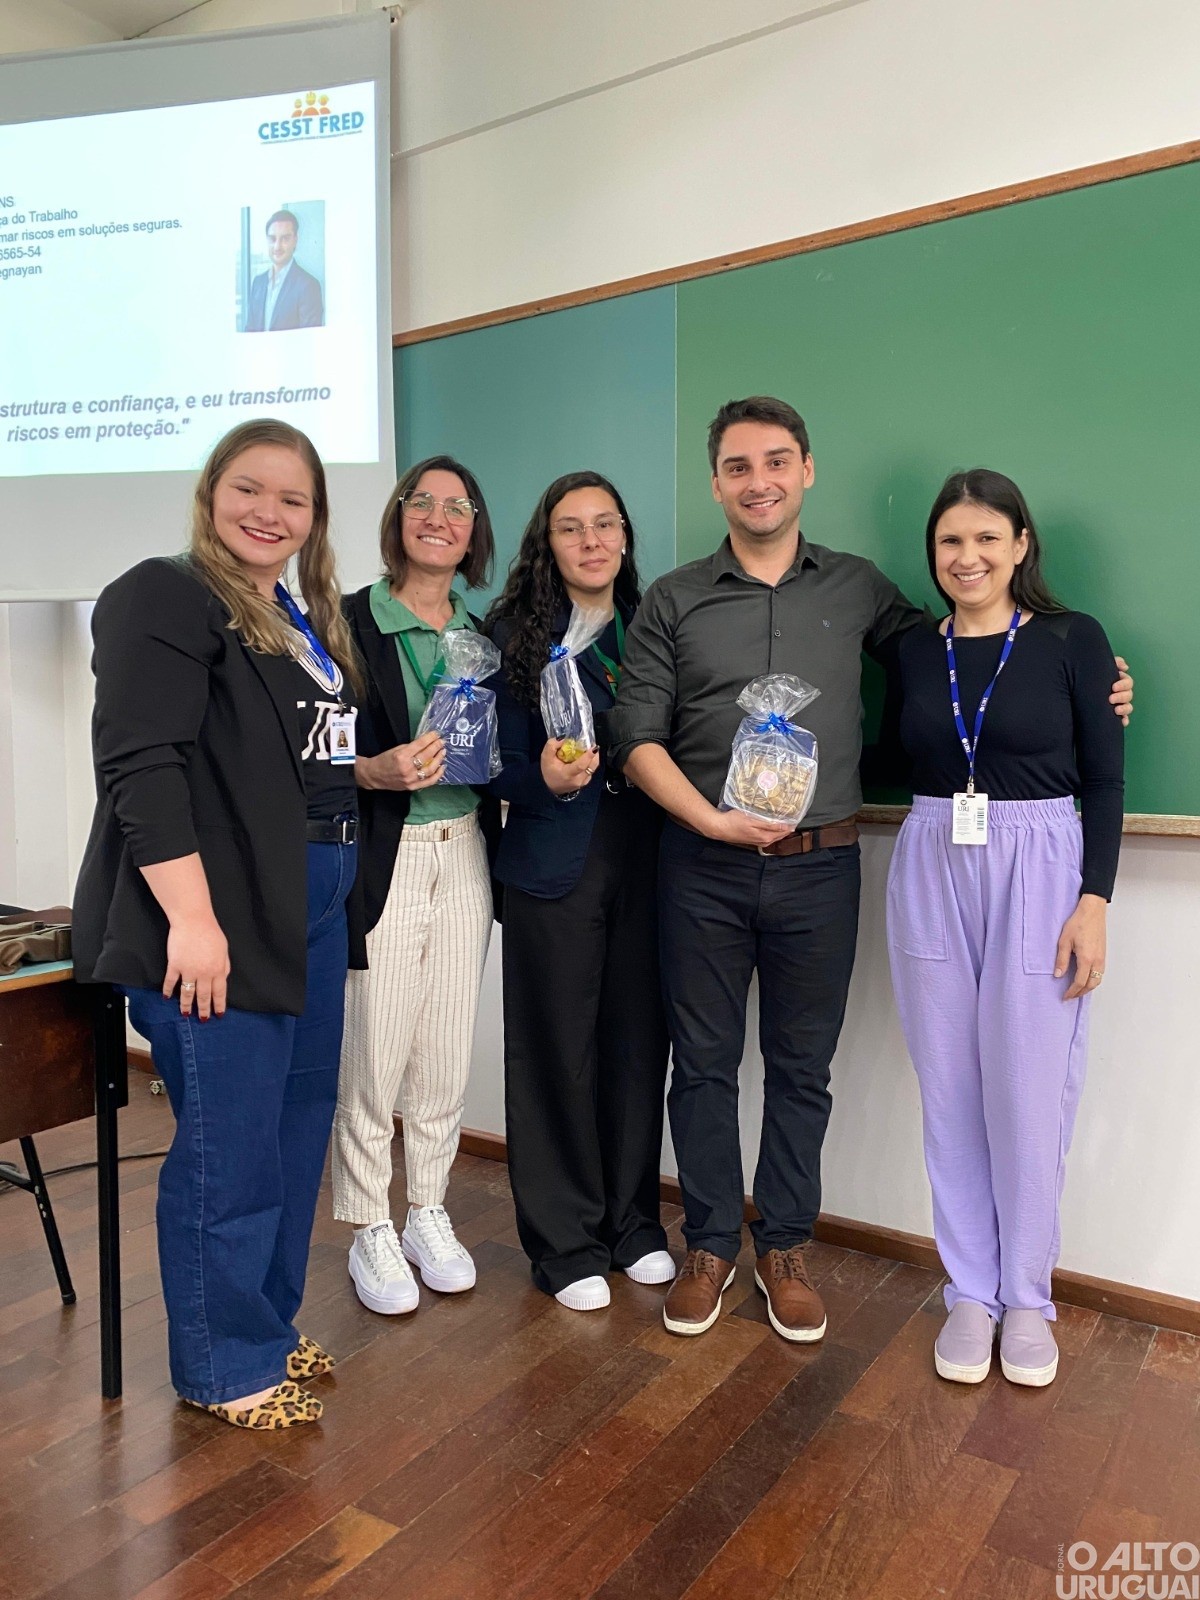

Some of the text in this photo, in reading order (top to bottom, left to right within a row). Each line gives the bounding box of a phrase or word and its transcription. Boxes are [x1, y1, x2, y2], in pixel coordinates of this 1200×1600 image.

[258, 118, 313, 140] CESST
[319, 111, 364, 133] FRED
[12, 213, 26, 224] do
[29, 209, 78, 222] Trabalho
[22, 229, 54, 240] riscos
[57, 228, 75, 237] em
[79, 222, 129, 237] soluções
[133, 219, 182, 233] seguras.
[0, 265, 42, 280] gnayan
[0, 386, 331, 417] strutura e confiança, e eu transformo
[7, 426, 59, 442] riscos
[65, 425, 91, 439] em
[450, 733, 475, 747] URI
